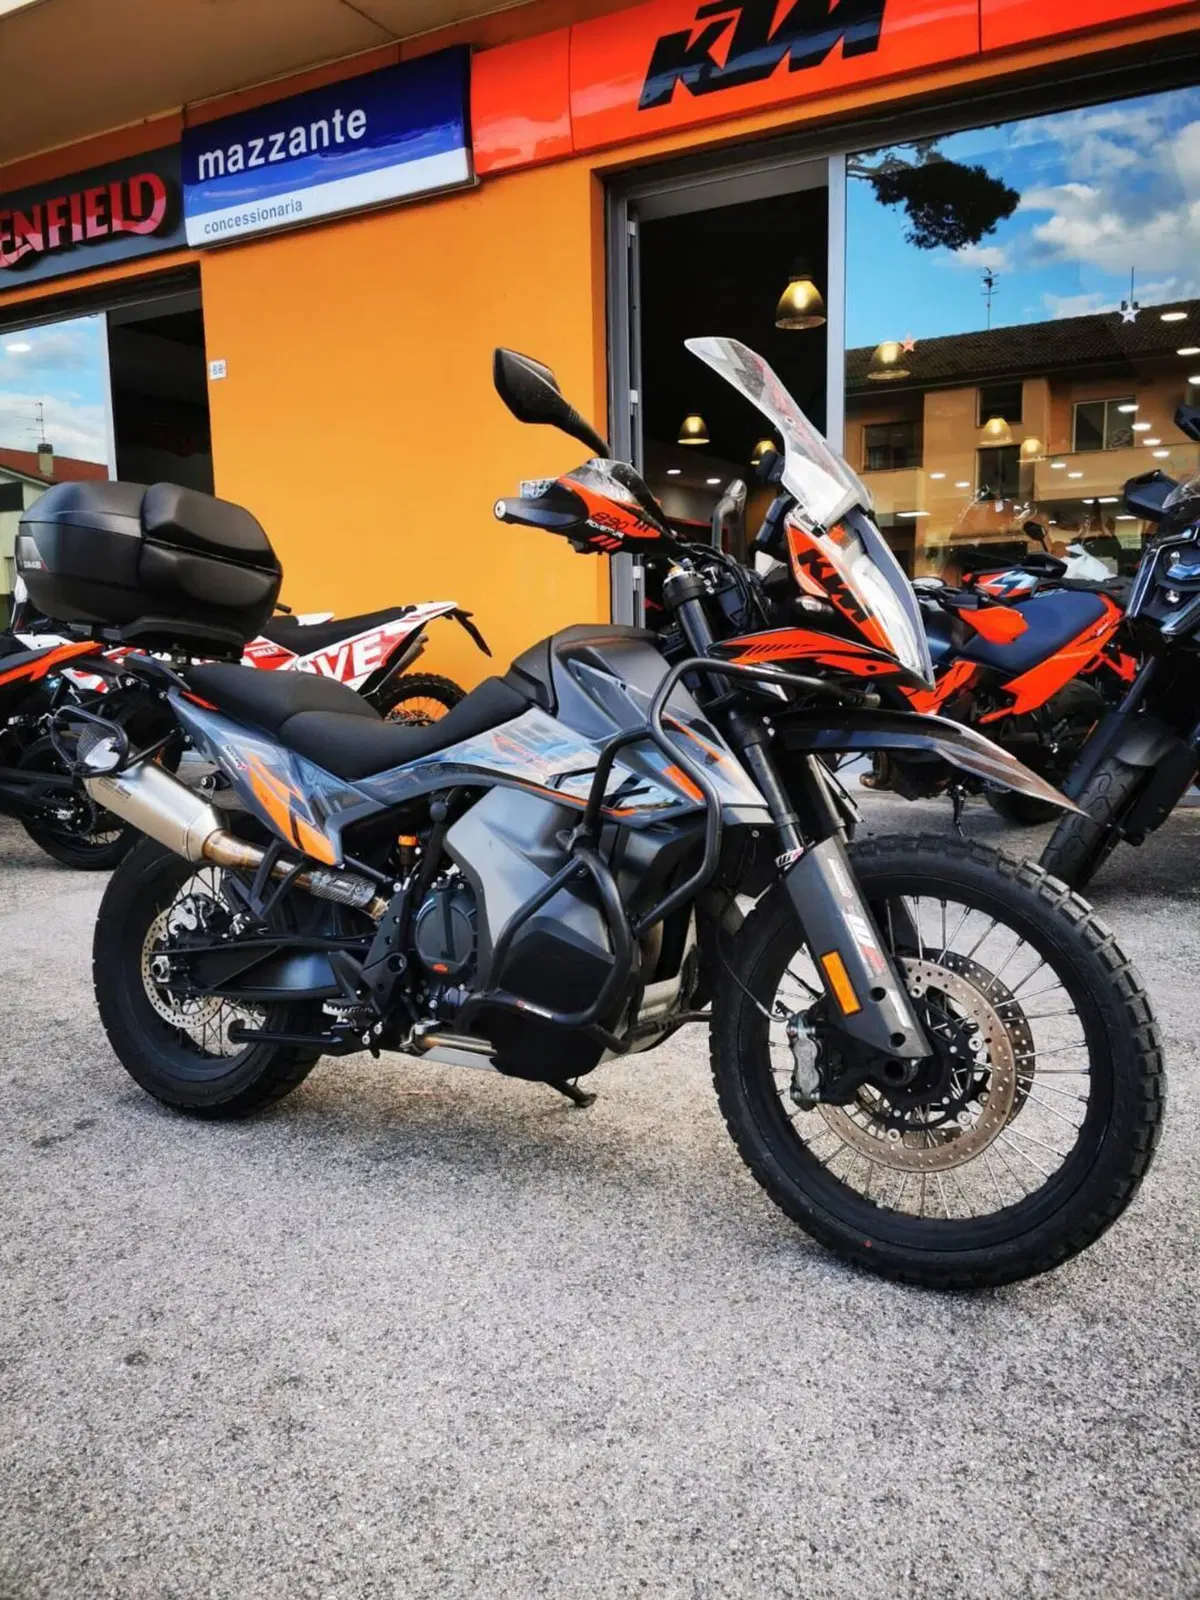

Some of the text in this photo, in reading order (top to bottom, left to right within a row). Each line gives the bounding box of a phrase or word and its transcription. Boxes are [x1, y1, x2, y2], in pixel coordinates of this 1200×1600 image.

[638, 0, 886, 111] KTM
[198, 108, 367, 181] mazzante
[204, 198, 303, 234] concessionaria
[797, 548, 874, 622] KTM
